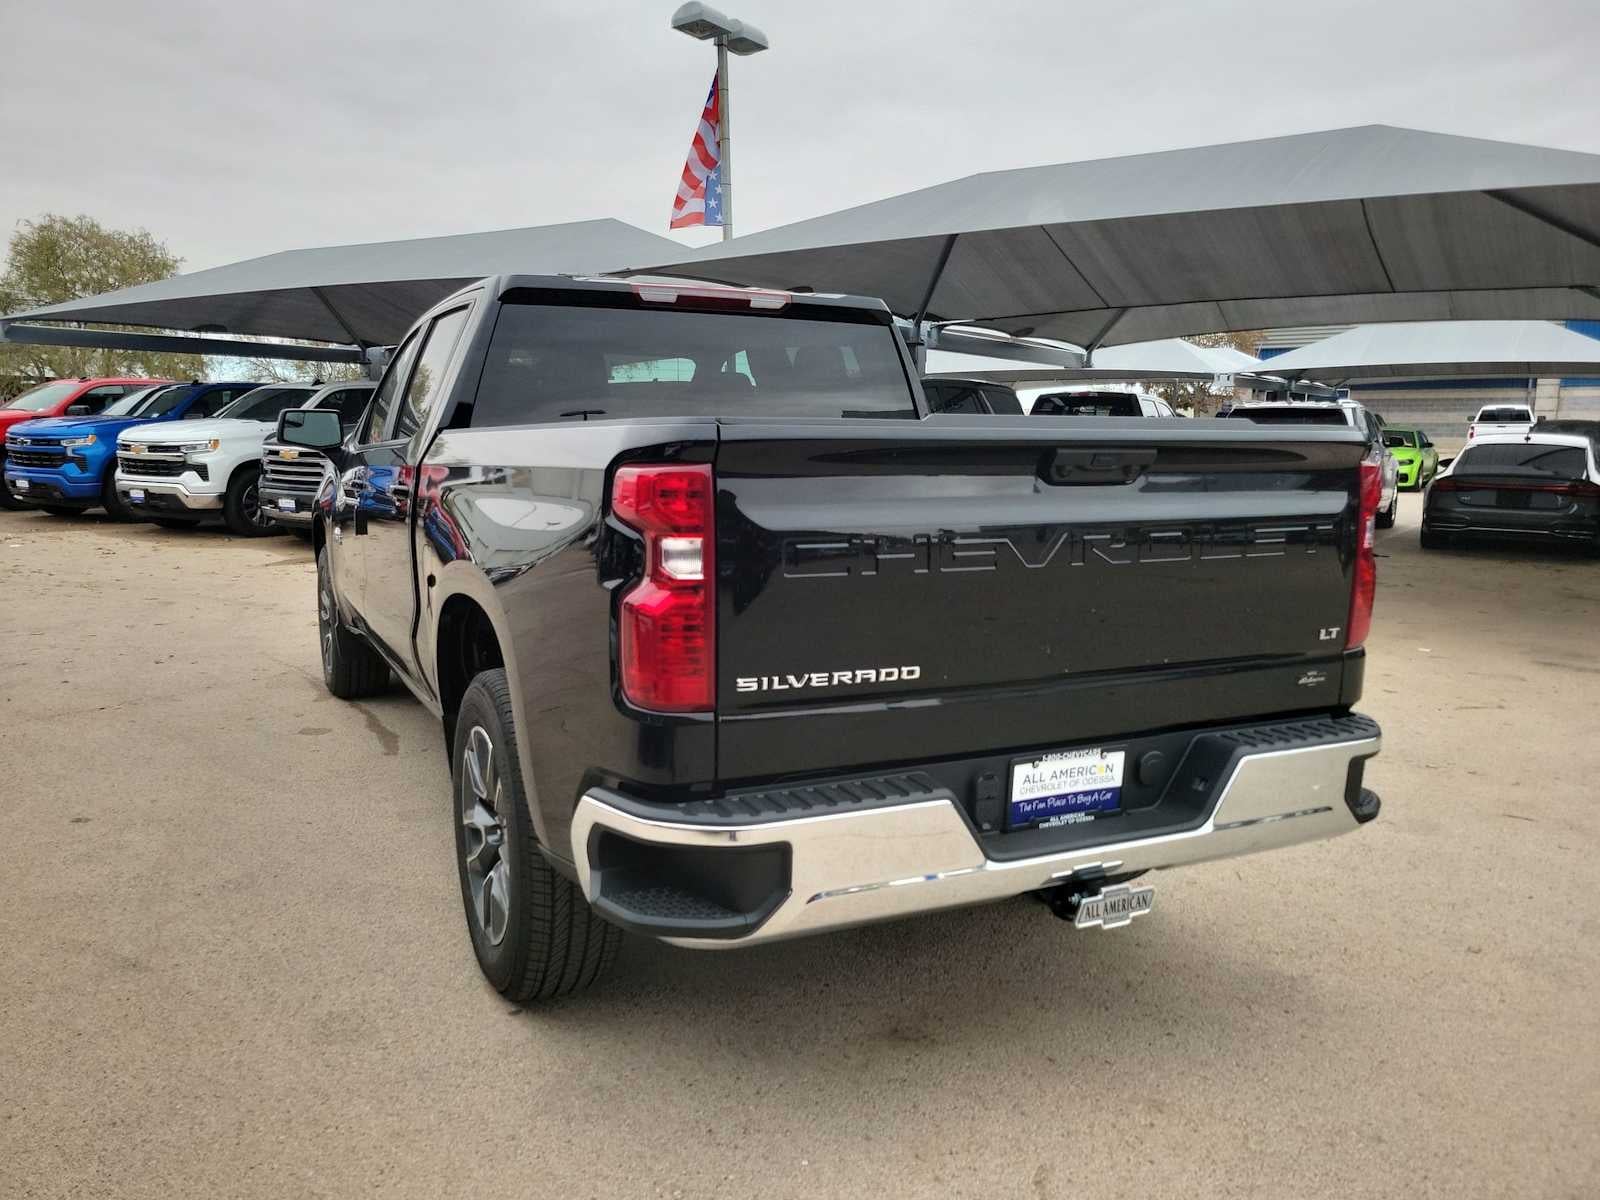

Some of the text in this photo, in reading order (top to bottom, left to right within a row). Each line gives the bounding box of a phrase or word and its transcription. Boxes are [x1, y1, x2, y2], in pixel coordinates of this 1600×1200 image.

[783, 522, 1334, 577] CHEVROLET
[1319, 627, 1341, 640] LT
[735, 665, 921, 692] SILVERADO
[1019, 775, 1115, 795] CHEVROLET OF ODESSA
[1022, 773, 1045, 785] ALL
[1019, 802, 1032, 813] The
[1047, 797, 1066, 808] Place
[1068, 795, 1076, 805] To
[1076, 793, 1091, 806] Buy
[1091, 792, 1099, 802] A
[1100, 791, 1112, 801] Car
[1086, 894, 1149, 919] ALL AMERICAN
